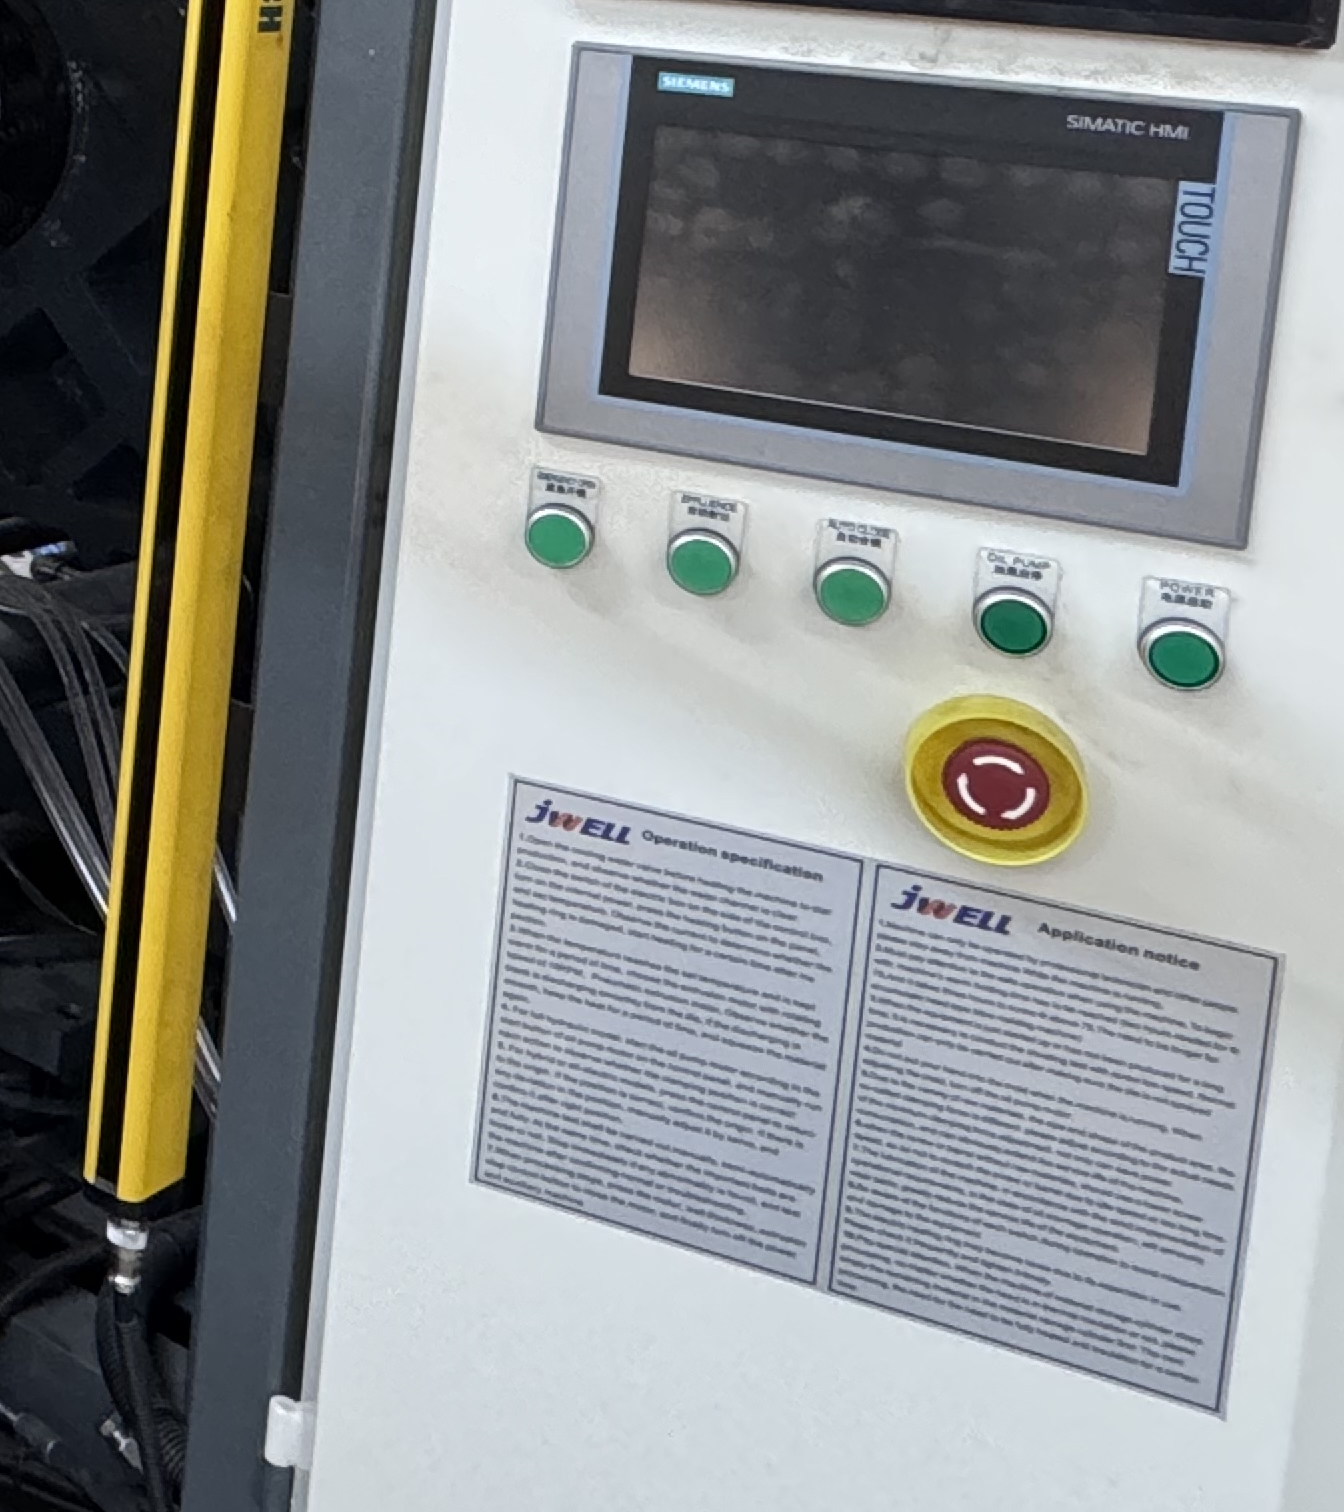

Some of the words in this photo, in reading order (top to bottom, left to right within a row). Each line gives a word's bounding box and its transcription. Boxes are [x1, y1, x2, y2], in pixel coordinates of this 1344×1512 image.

[662, 75, 730, 93] SIEMENS
[1066, 114, 1147, 136] SIMATIC
[1148, 123, 1191, 140] HMI
[1173, 186, 1216, 274] TOUCH
[642, 829, 718, 857] Operation
[721, 849, 824, 882] specification
[1037, 921, 1140, 957] Application
[1143, 947, 1201, 971] notice
